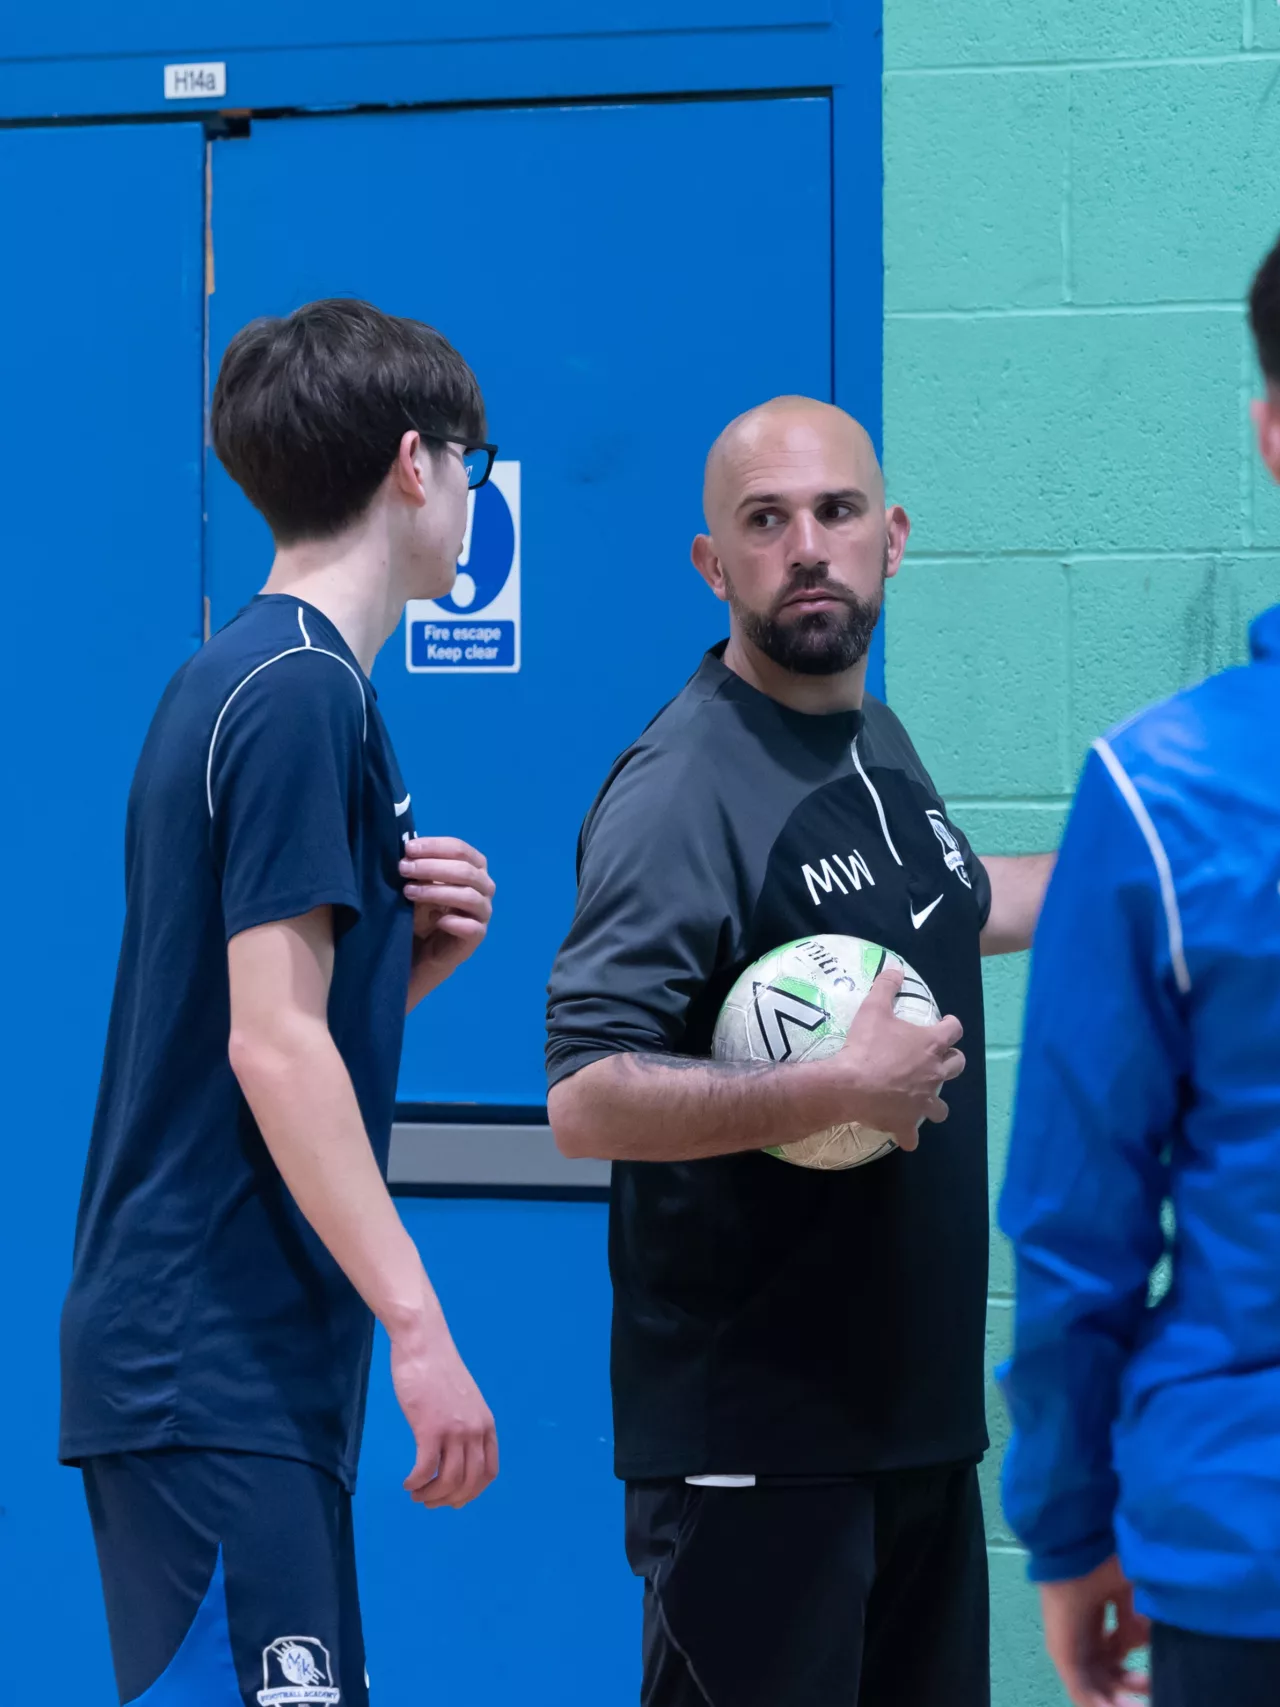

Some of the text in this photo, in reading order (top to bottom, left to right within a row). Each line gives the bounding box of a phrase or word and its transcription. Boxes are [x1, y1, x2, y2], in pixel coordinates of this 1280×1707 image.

[173, 68, 217, 93] H14a
[424, 623, 502, 644] Fire escape
[426, 643, 500, 663] Keep clear
[801, 849, 876, 906] MW
